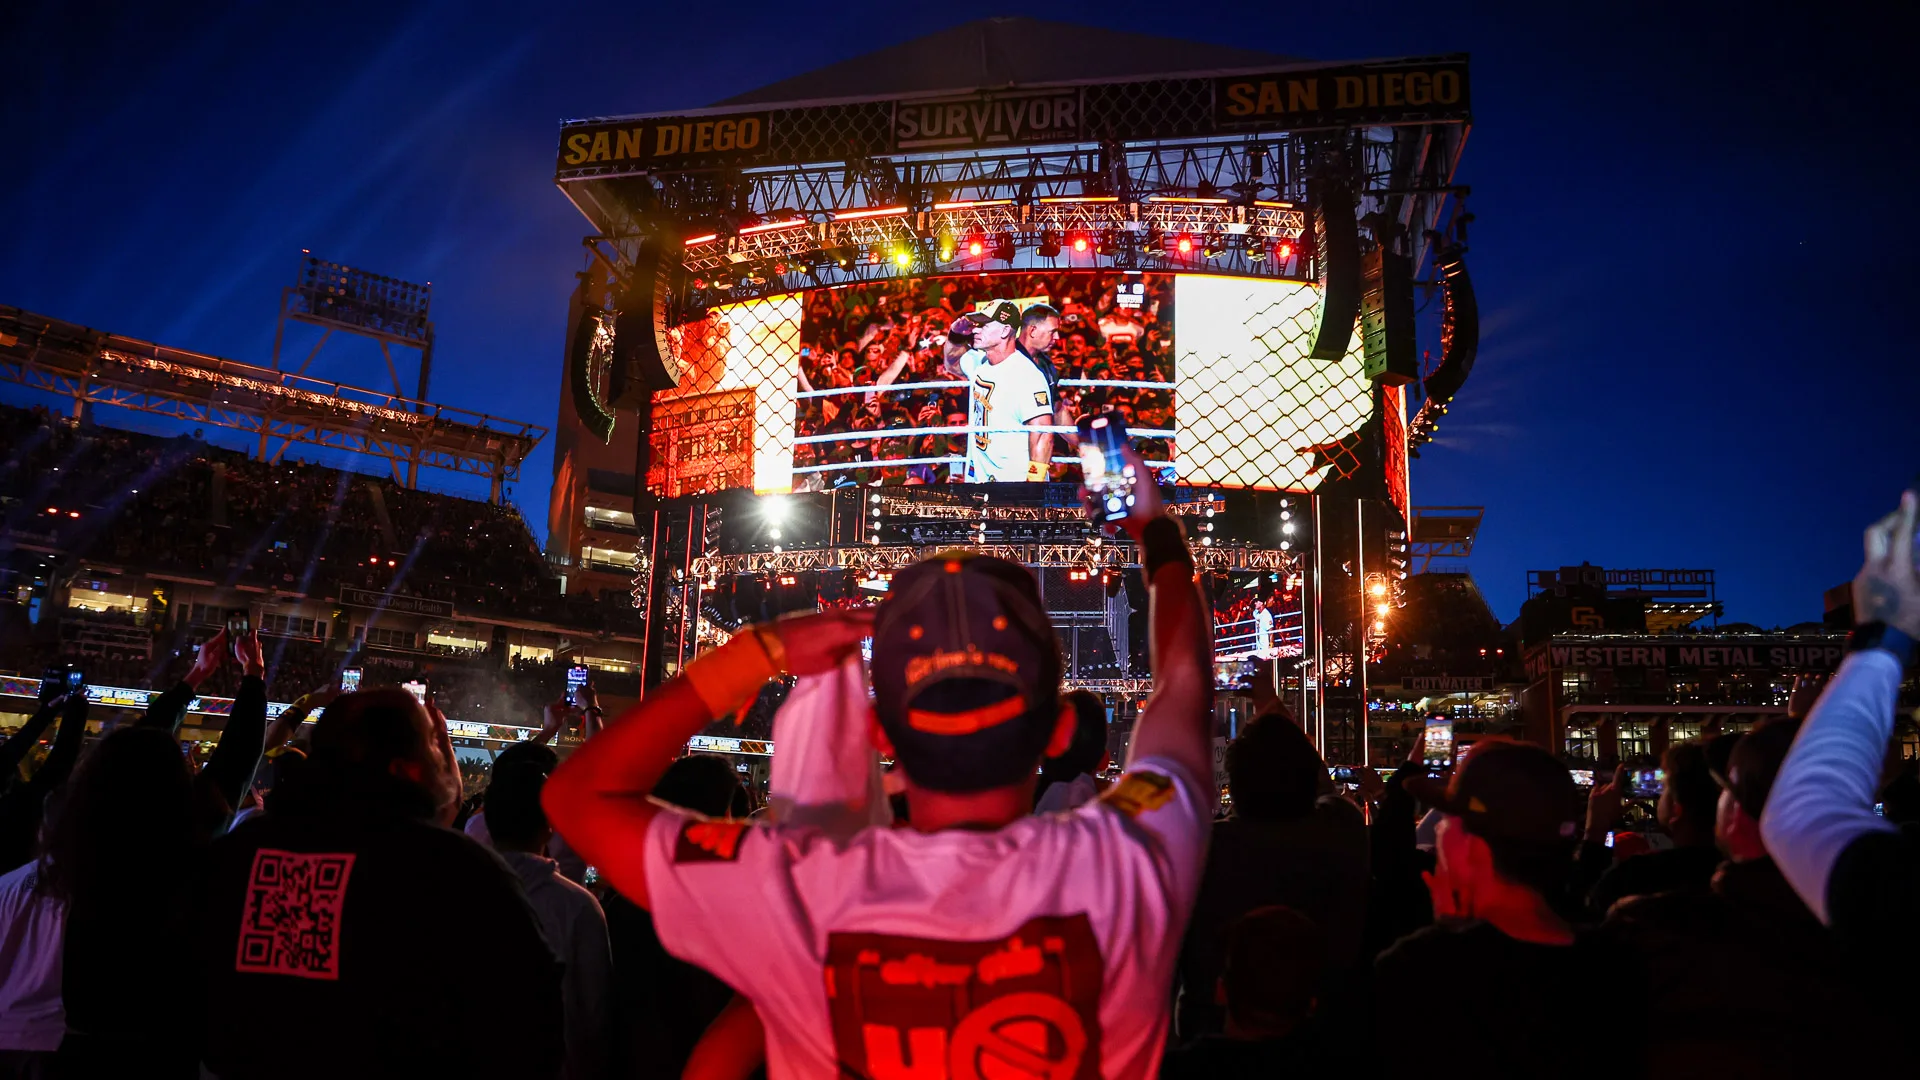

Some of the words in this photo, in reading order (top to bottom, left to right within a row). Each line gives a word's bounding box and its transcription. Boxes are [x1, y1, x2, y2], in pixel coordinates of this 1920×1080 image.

[1225, 78, 1319, 116] SAN
[1333, 69, 1461, 110] DIEGO
[897, 97, 1077, 141] SURVIVOR
[564, 127, 643, 165] SAN
[653, 118, 761, 157] DIEGO
[353, 591, 368, 603] UC
[1551, 646, 1666, 667] WESTERN
[1680, 646, 1763, 667] METAL
[1412, 677, 1483, 691] CUTWATER
